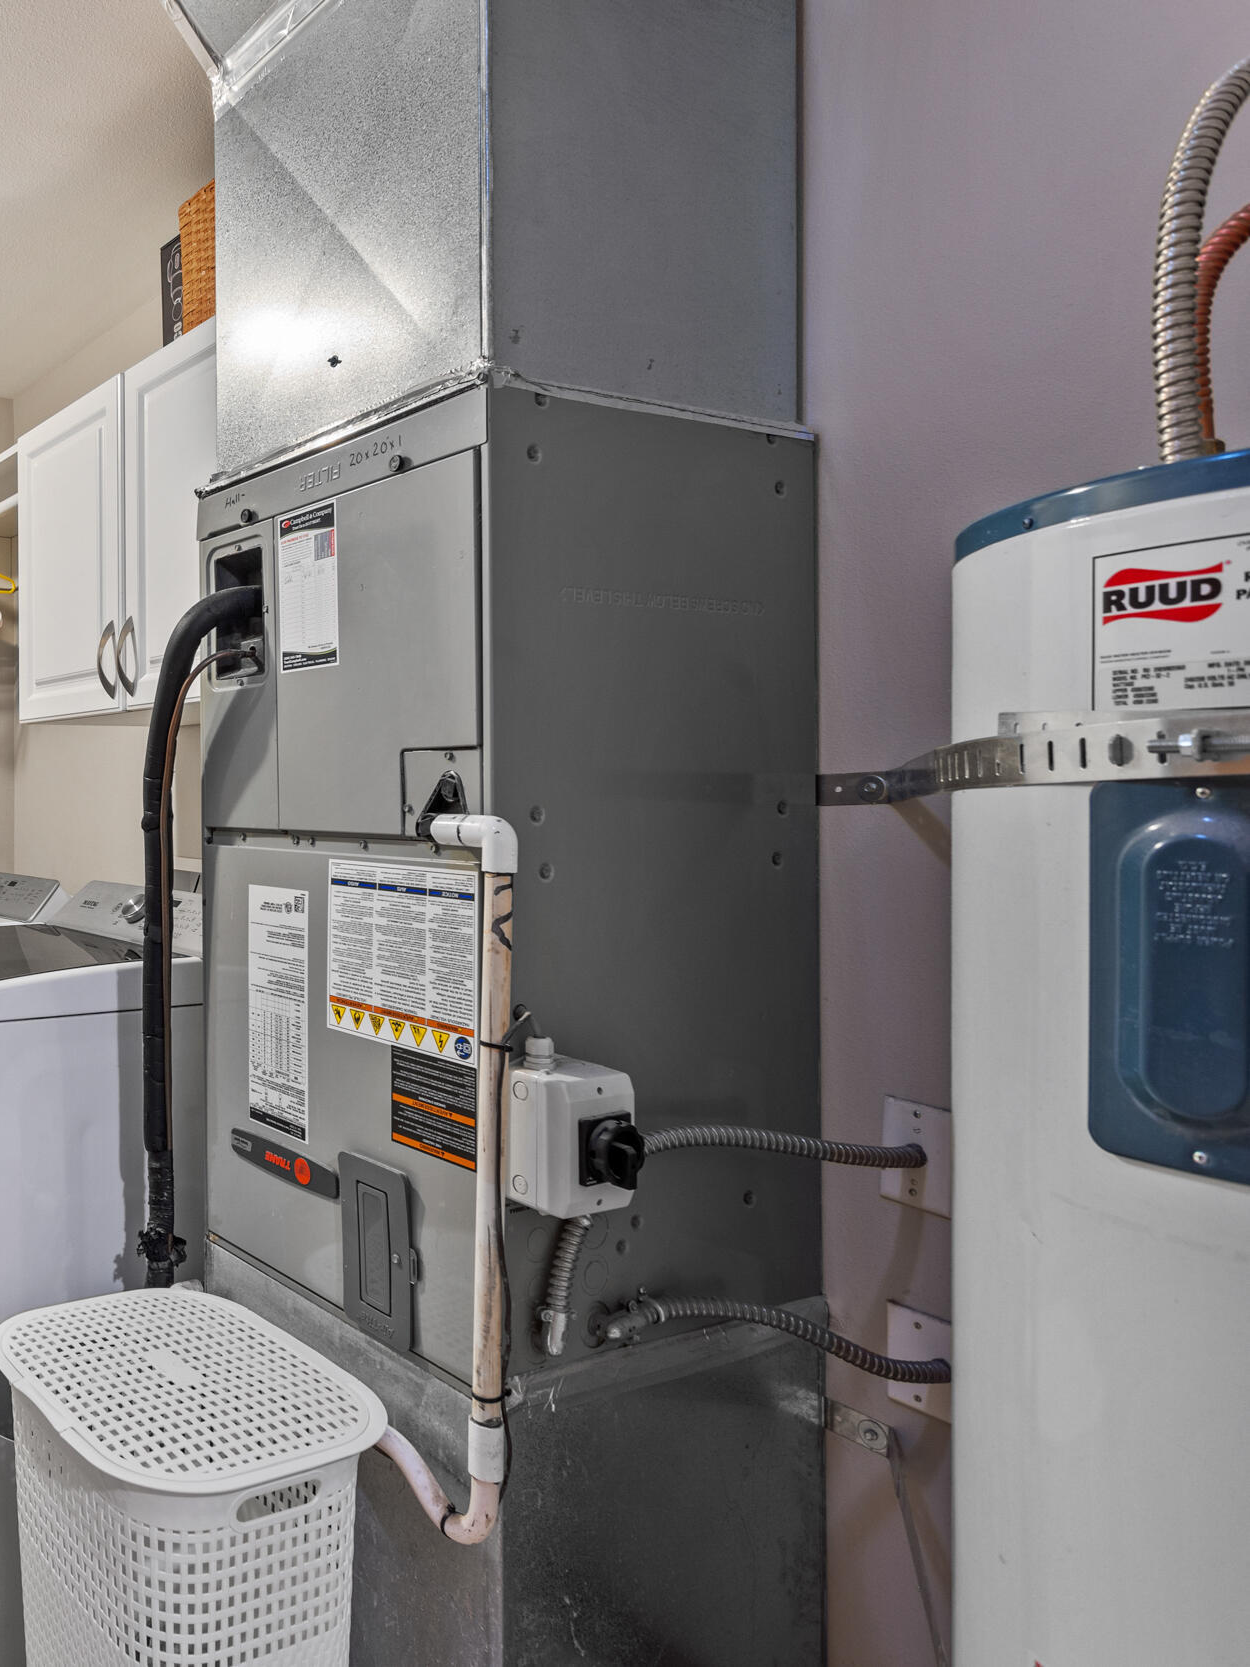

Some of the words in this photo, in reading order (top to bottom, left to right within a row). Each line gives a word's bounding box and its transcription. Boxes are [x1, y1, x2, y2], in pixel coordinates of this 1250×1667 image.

[300, 462, 341, 492] FILTER
[1102, 577, 1223, 614] RUUD
[264, 1150, 291, 1171] TRANE
